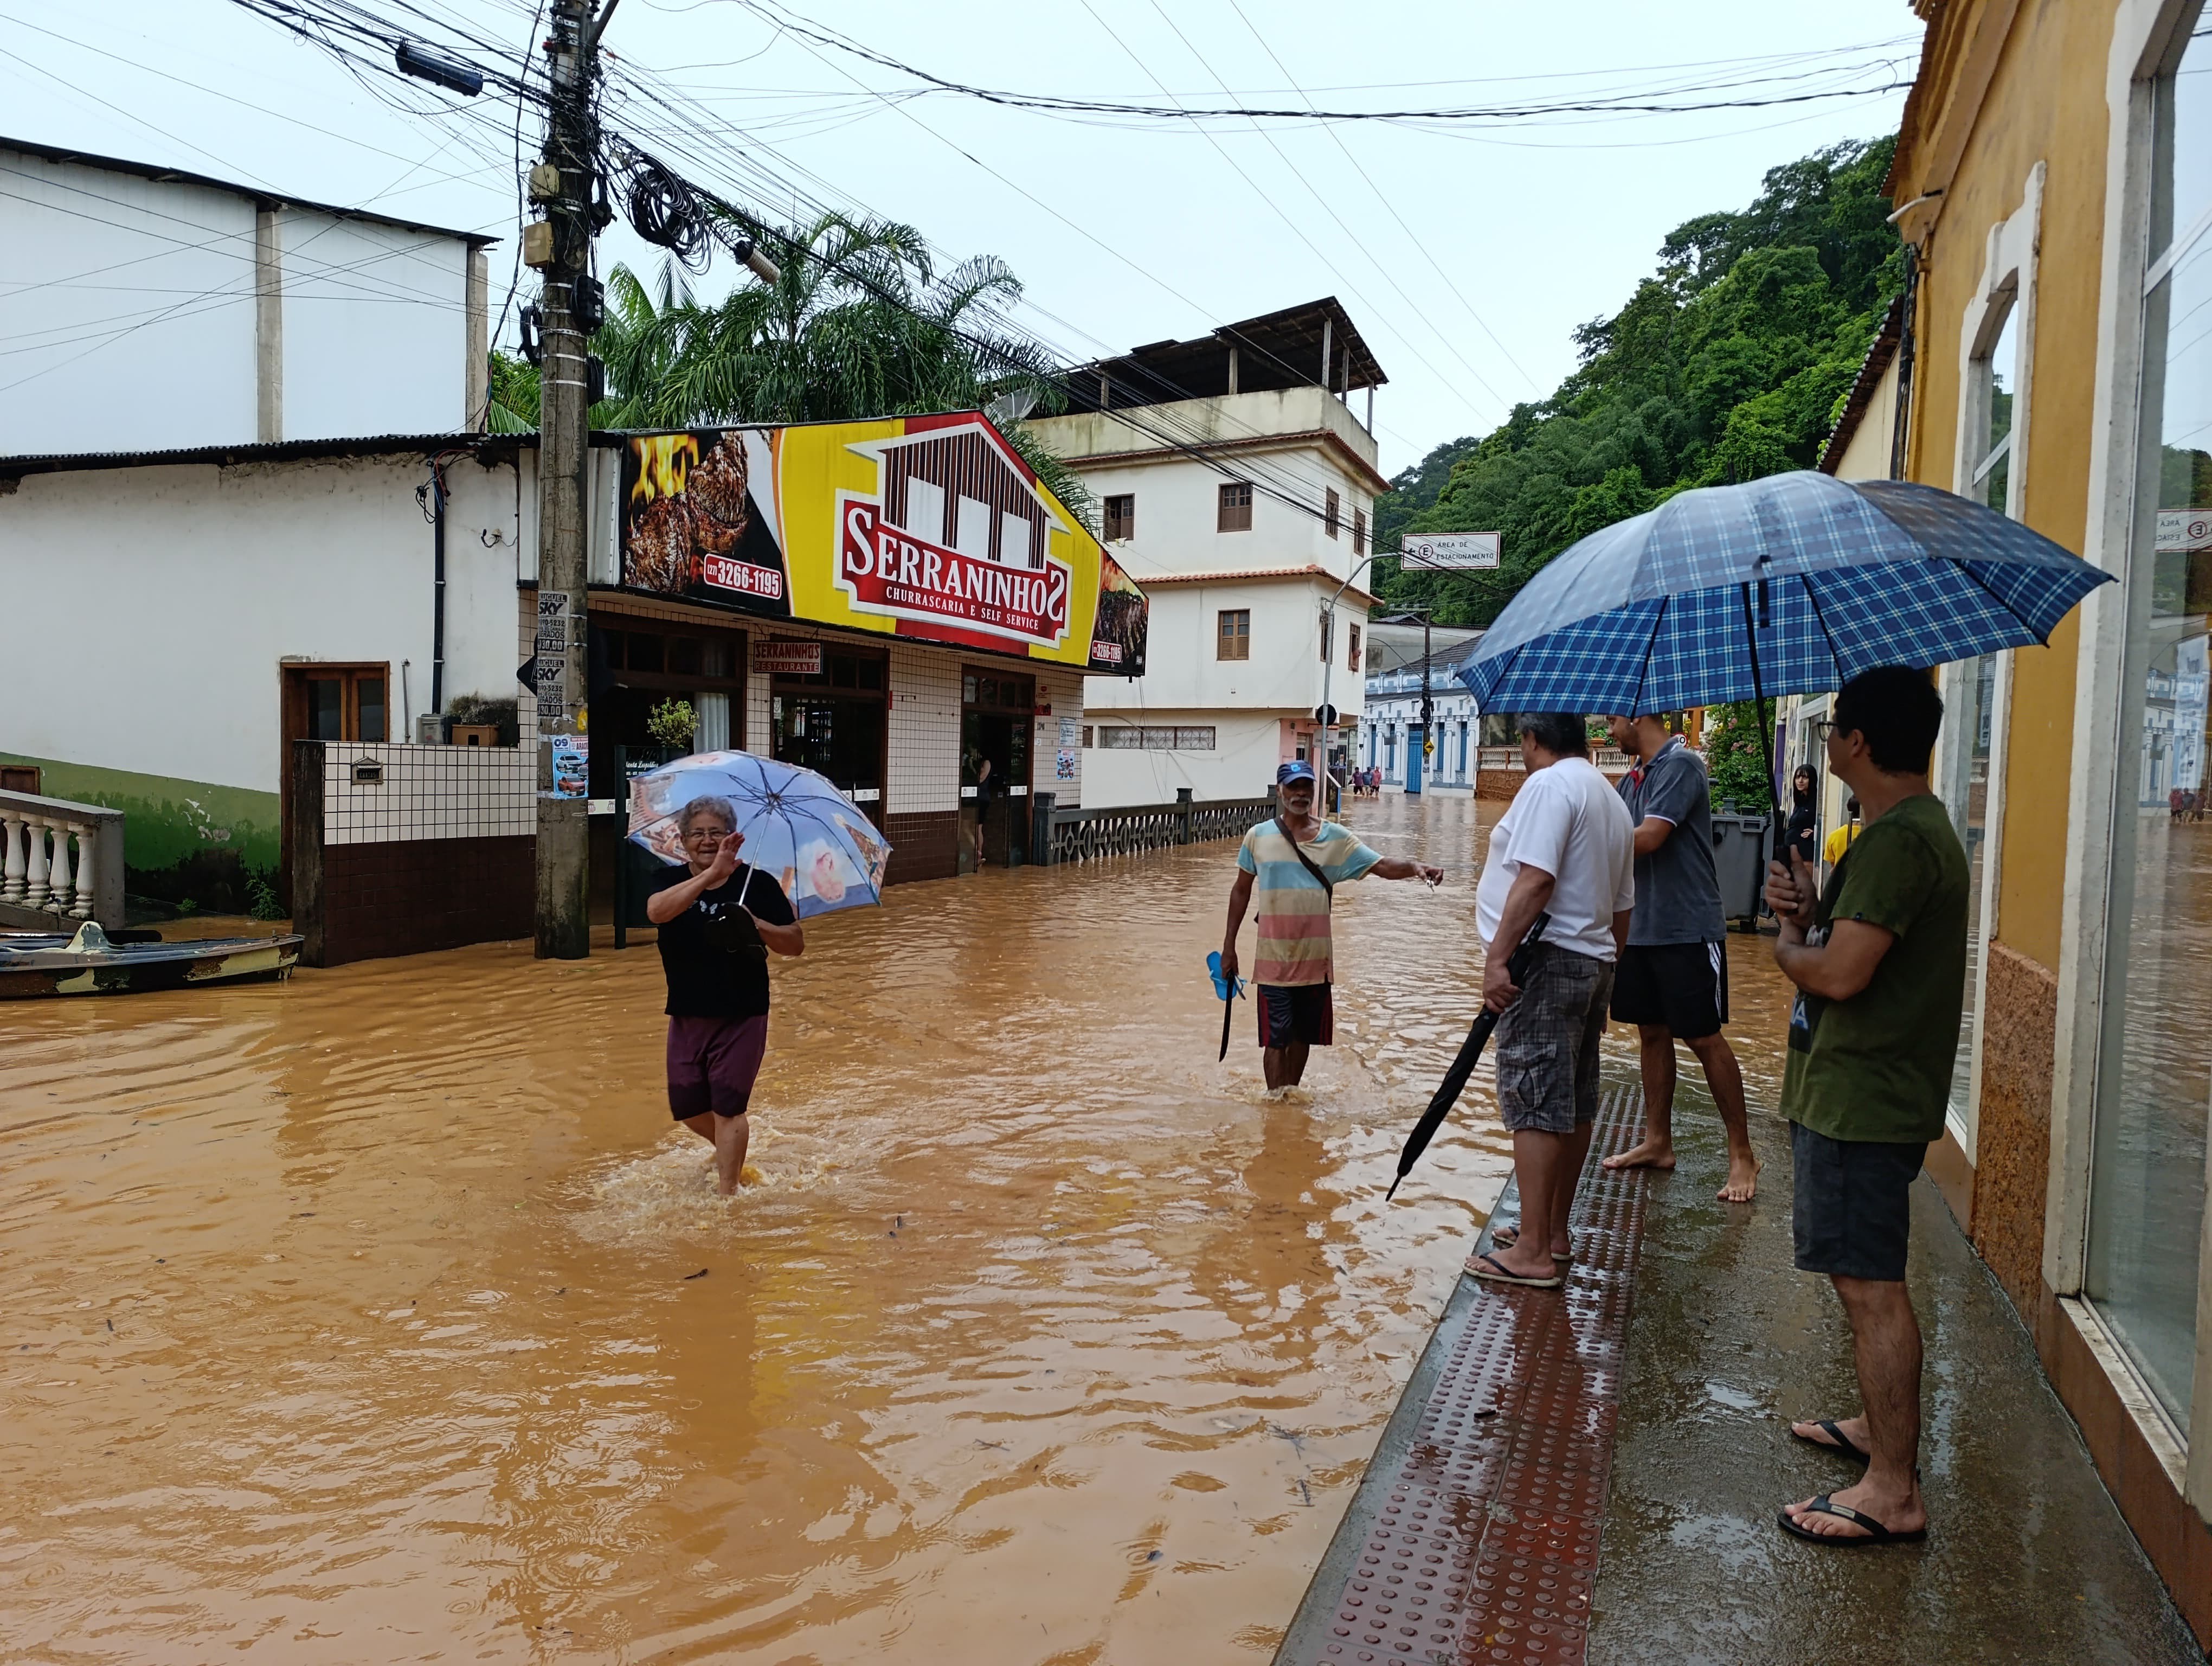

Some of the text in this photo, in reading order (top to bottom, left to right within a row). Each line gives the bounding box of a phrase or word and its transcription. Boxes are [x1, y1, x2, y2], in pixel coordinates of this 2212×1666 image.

[1423, 547, 1429, 556] E
[846, 507, 1065, 621] SERRANINHOS
[707, 561, 779, 595] (27) 3266-1195
[538, 593, 565, 602] LUGUEL
[539, 601, 564, 615] SKY
[886, 586, 1039, 630] CHURRASCARIA E SELF SERVICE
[755, 643, 820, 659] SERRANINHOS
[1097, 643, 1121, 660] 3266-1195
[755, 662, 819, 671] RESTAURANTE
[538, 668, 561, 681] SKY
